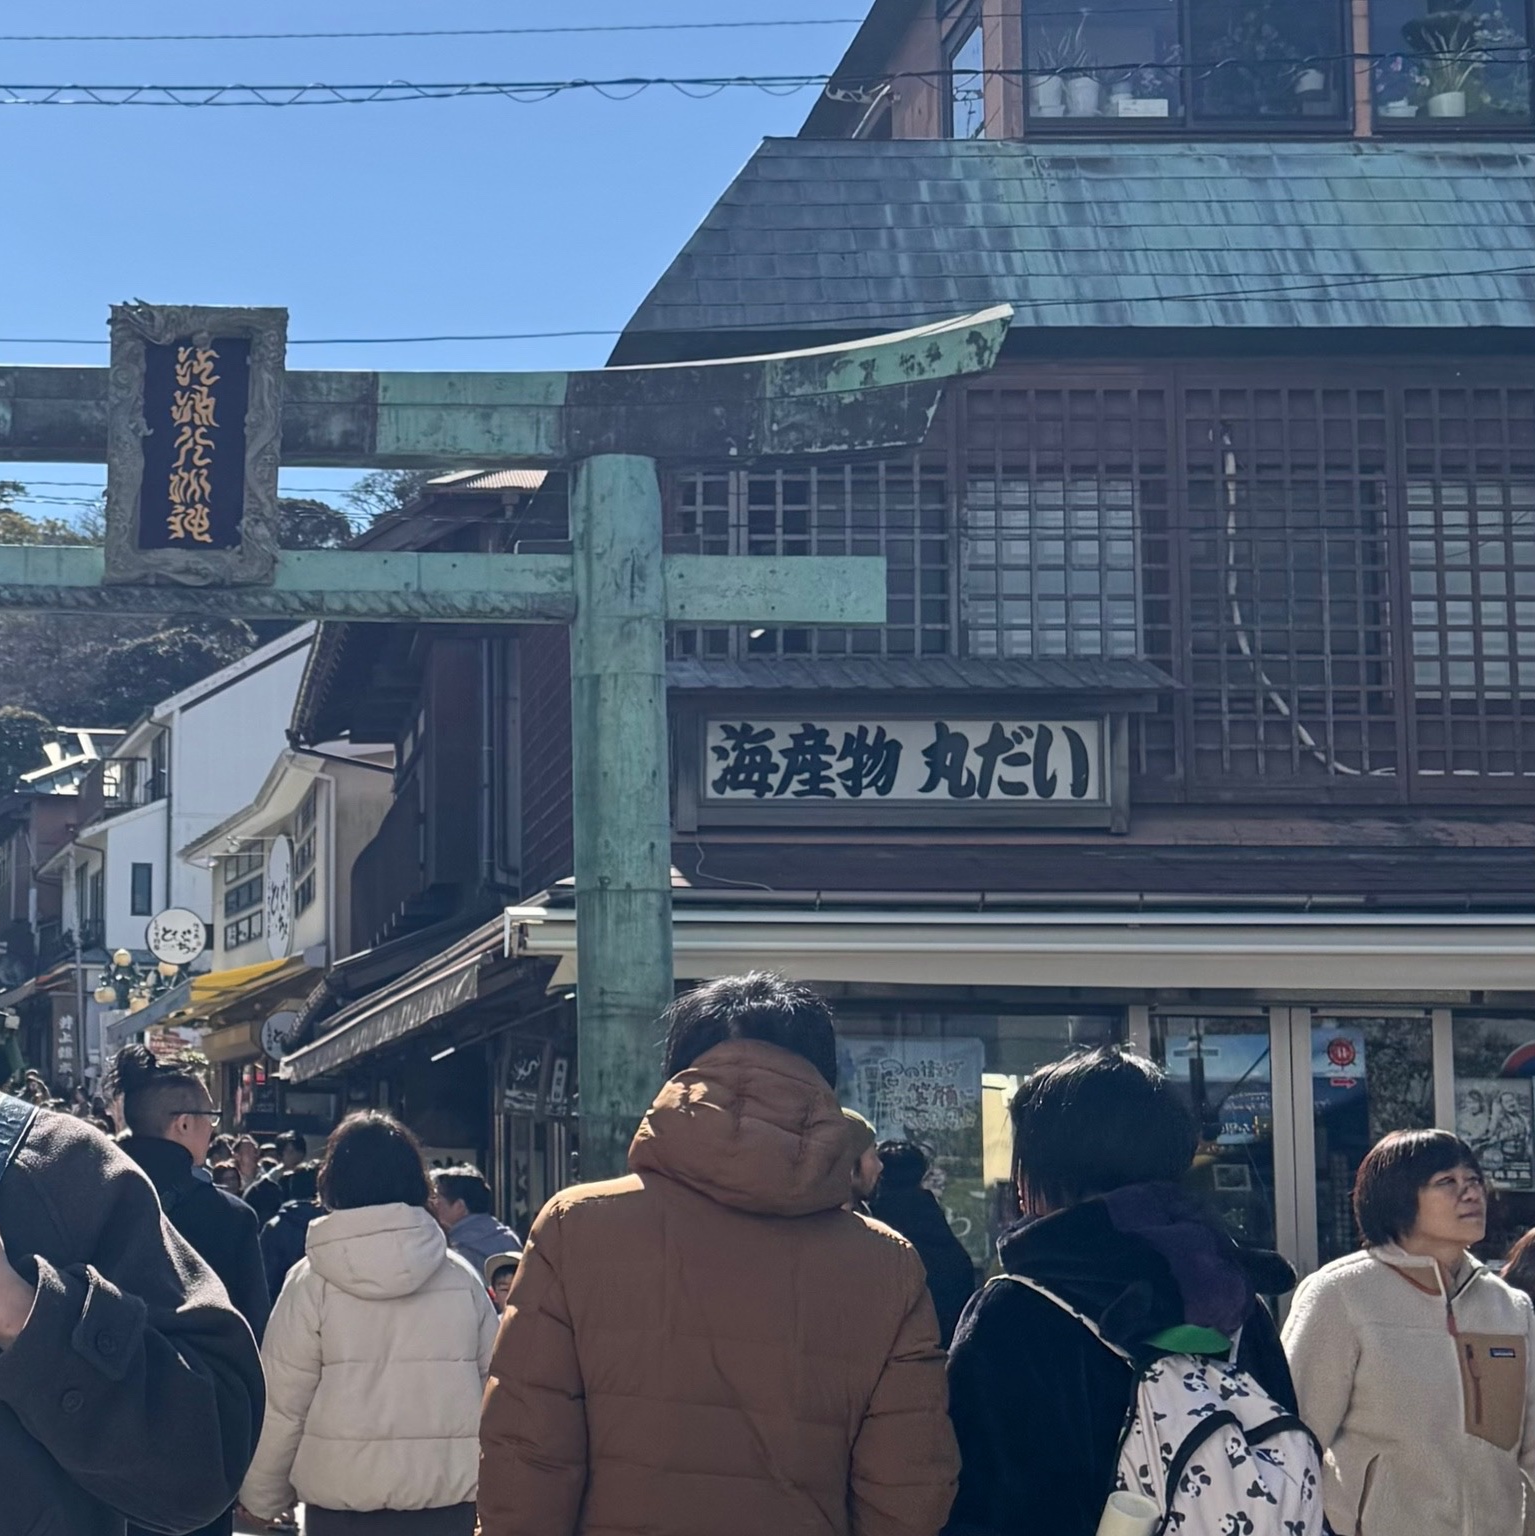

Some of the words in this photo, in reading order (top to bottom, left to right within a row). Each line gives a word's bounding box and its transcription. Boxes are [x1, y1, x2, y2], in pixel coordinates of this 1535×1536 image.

[710, 721, 904, 798] 海産物
[917, 721, 1090, 799] 丸だい
